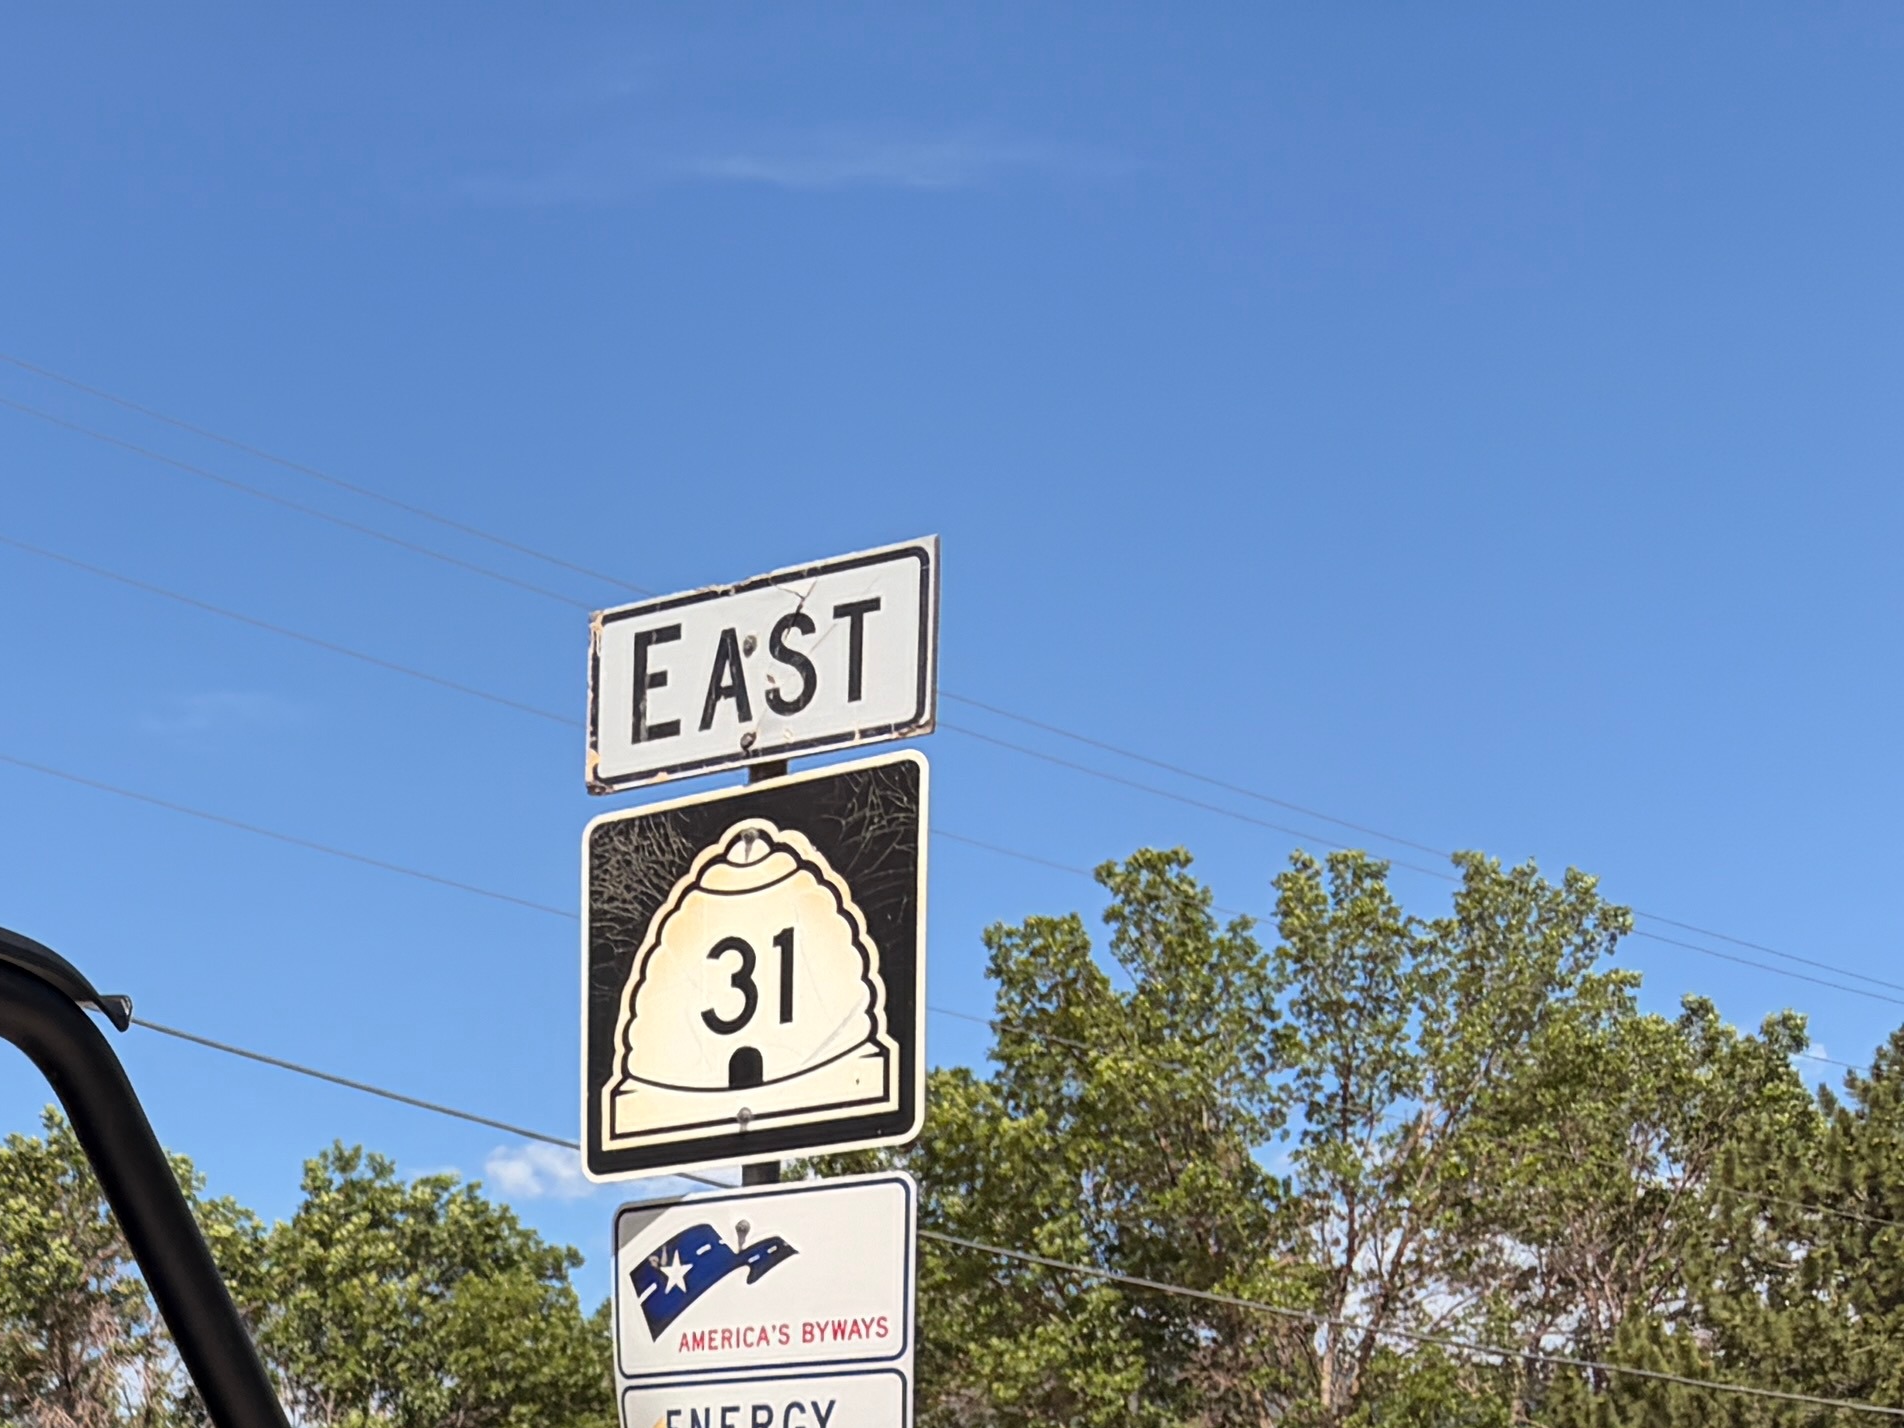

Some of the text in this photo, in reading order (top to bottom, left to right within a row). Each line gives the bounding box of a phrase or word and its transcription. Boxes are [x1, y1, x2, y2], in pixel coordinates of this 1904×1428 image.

[630, 596, 882, 745] EAST
[700, 926, 795, 1036] 31
[678, 1316, 890, 1353] AMERICA'S BYWAYS
